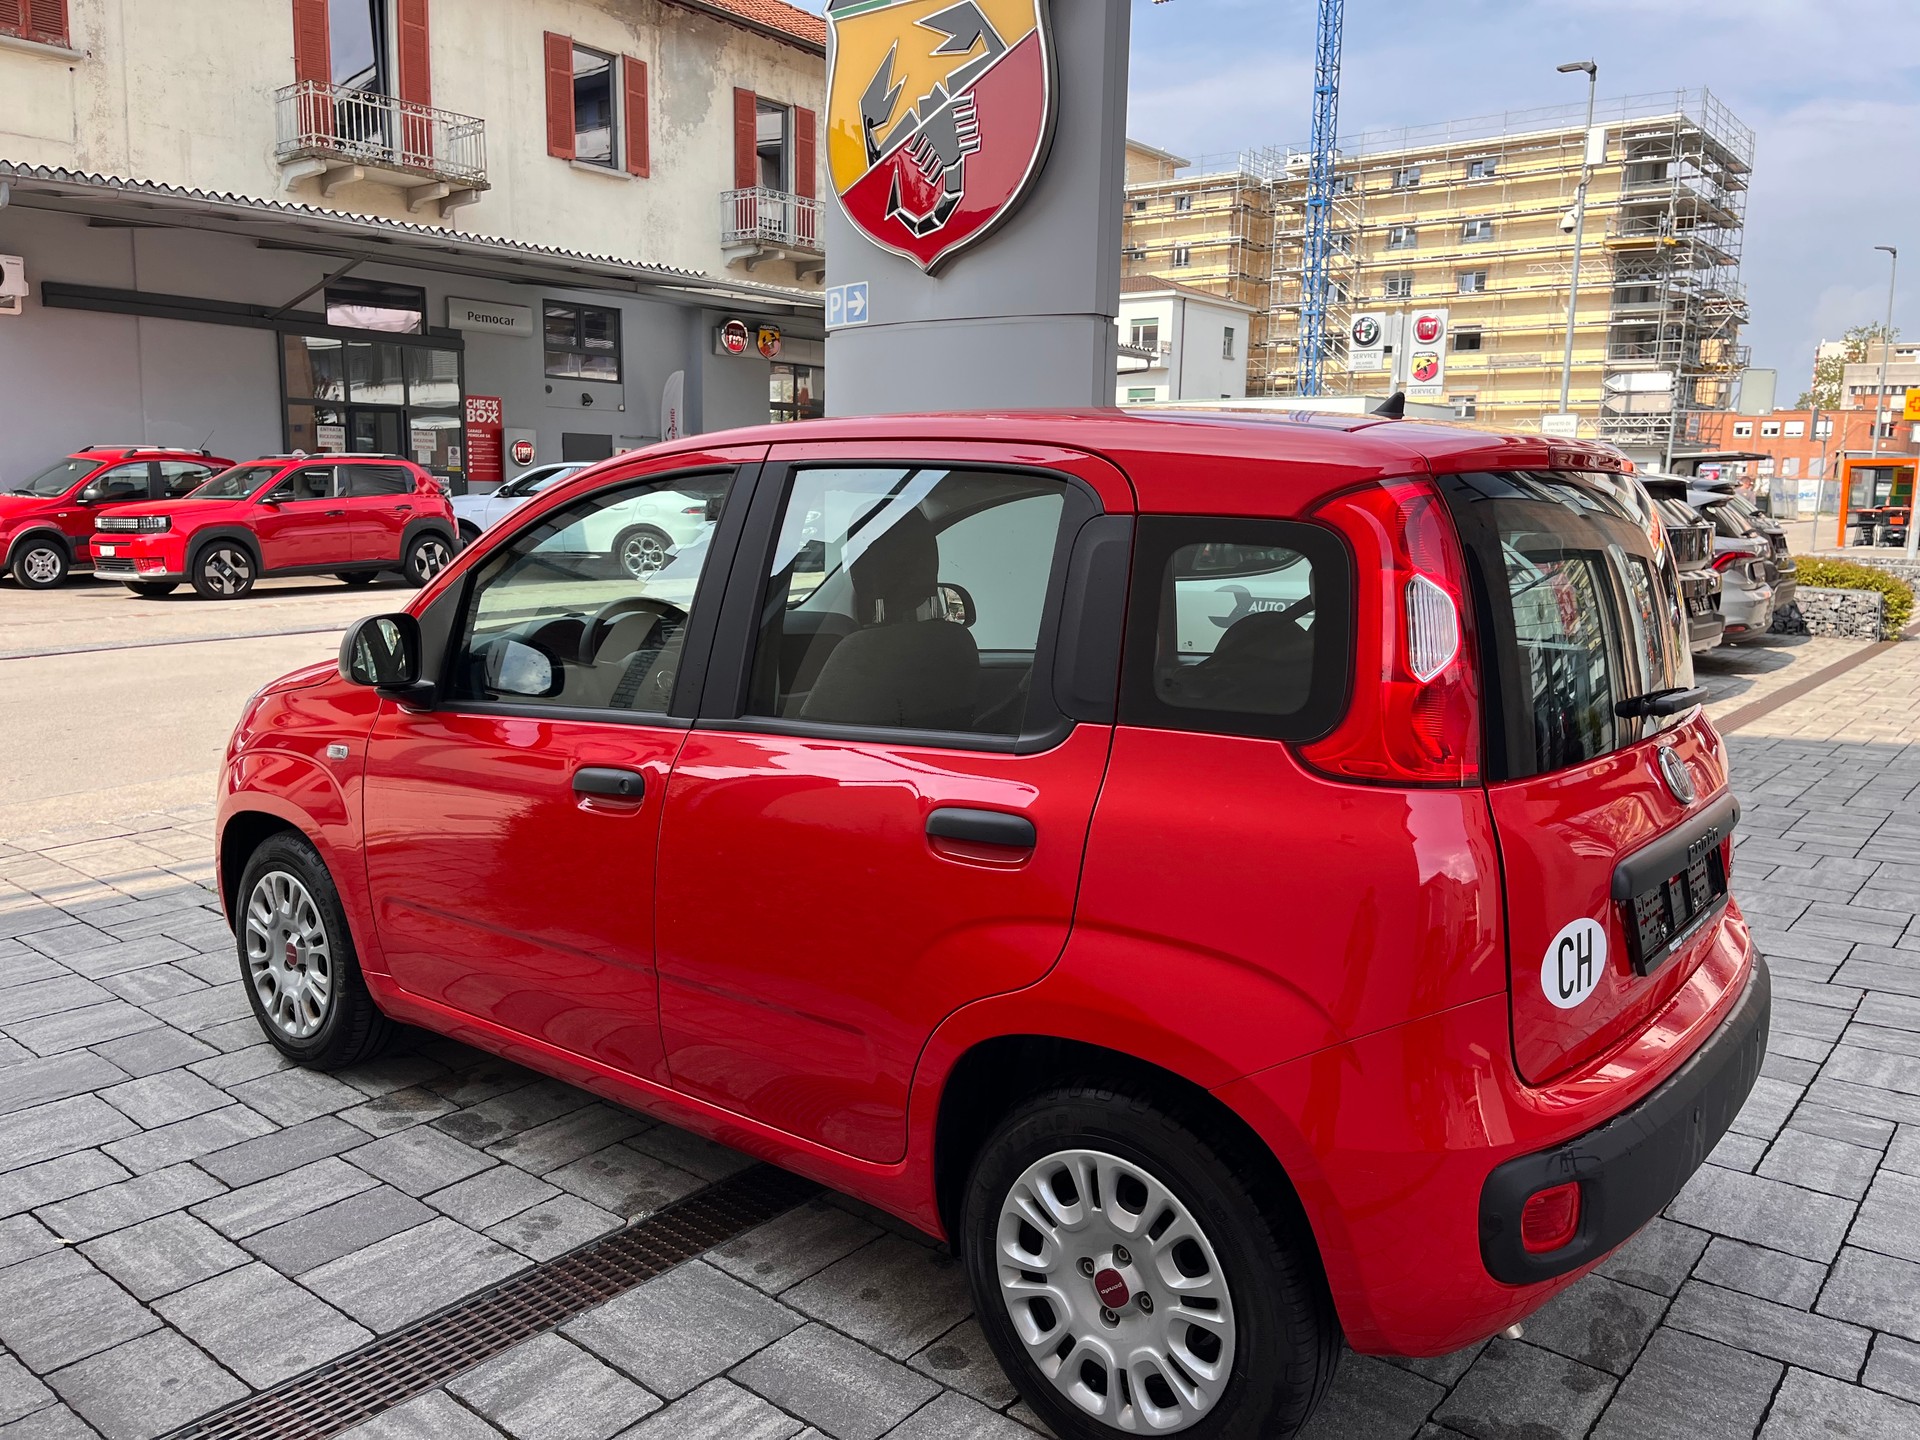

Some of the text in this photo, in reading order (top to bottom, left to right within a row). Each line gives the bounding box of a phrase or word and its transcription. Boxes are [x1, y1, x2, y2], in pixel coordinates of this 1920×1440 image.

[829, 291, 842, 323] P
[467, 311, 515, 326] Pemocar
[466, 398, 499, 410] CHECK
[517, 447, 532, 460] FIAT
[1248, 601, 1286, 613] AUTO
[1558, 928, 1592, 999] CH
[1100, 1281, 1123, 1295] panda
